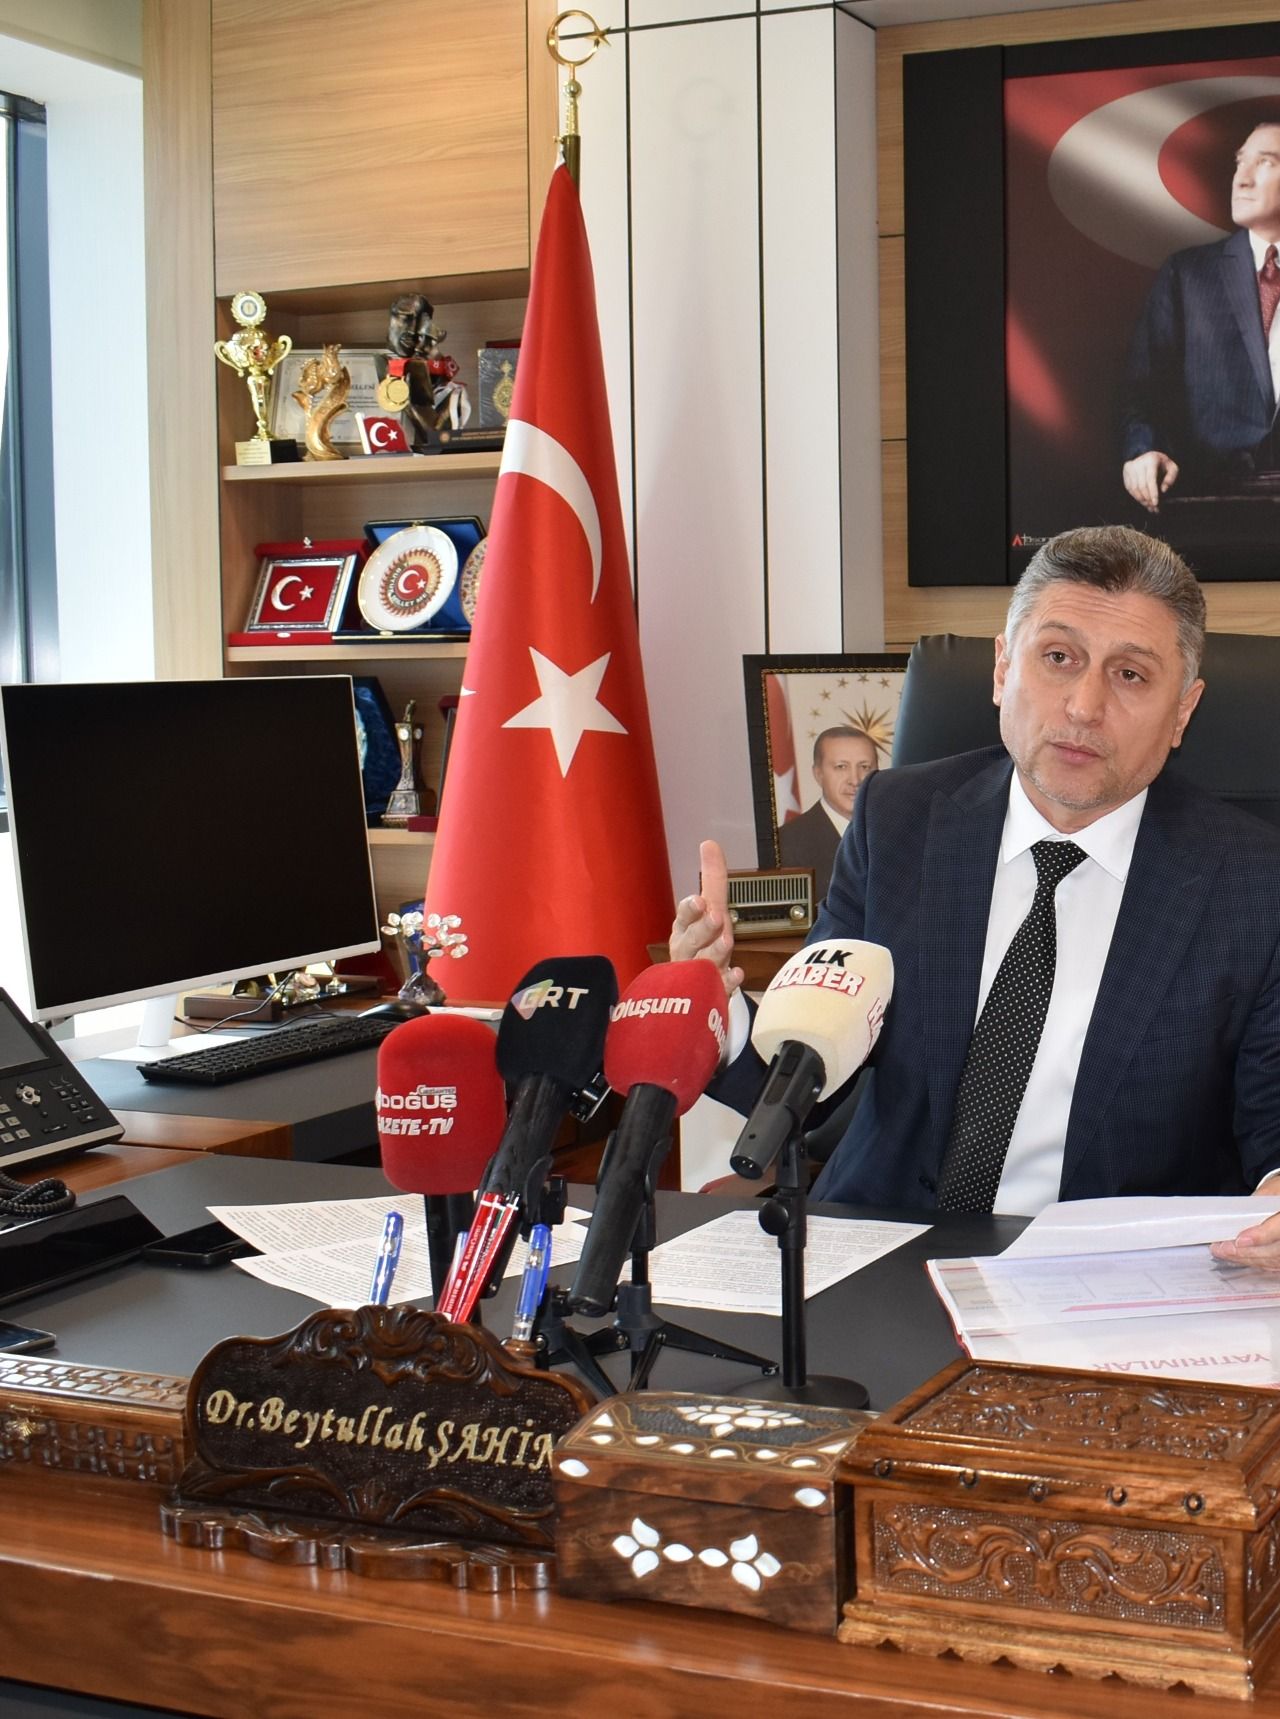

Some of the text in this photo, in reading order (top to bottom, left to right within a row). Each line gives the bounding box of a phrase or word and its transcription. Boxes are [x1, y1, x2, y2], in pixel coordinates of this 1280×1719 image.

[770, 966, 865, 997] HABER
[611, 997, 691, 1022] Oluşum
[377, 1115, 454, 1136] AZETE-TV
[427, 1419, 553, 1471] ŞAHİN
